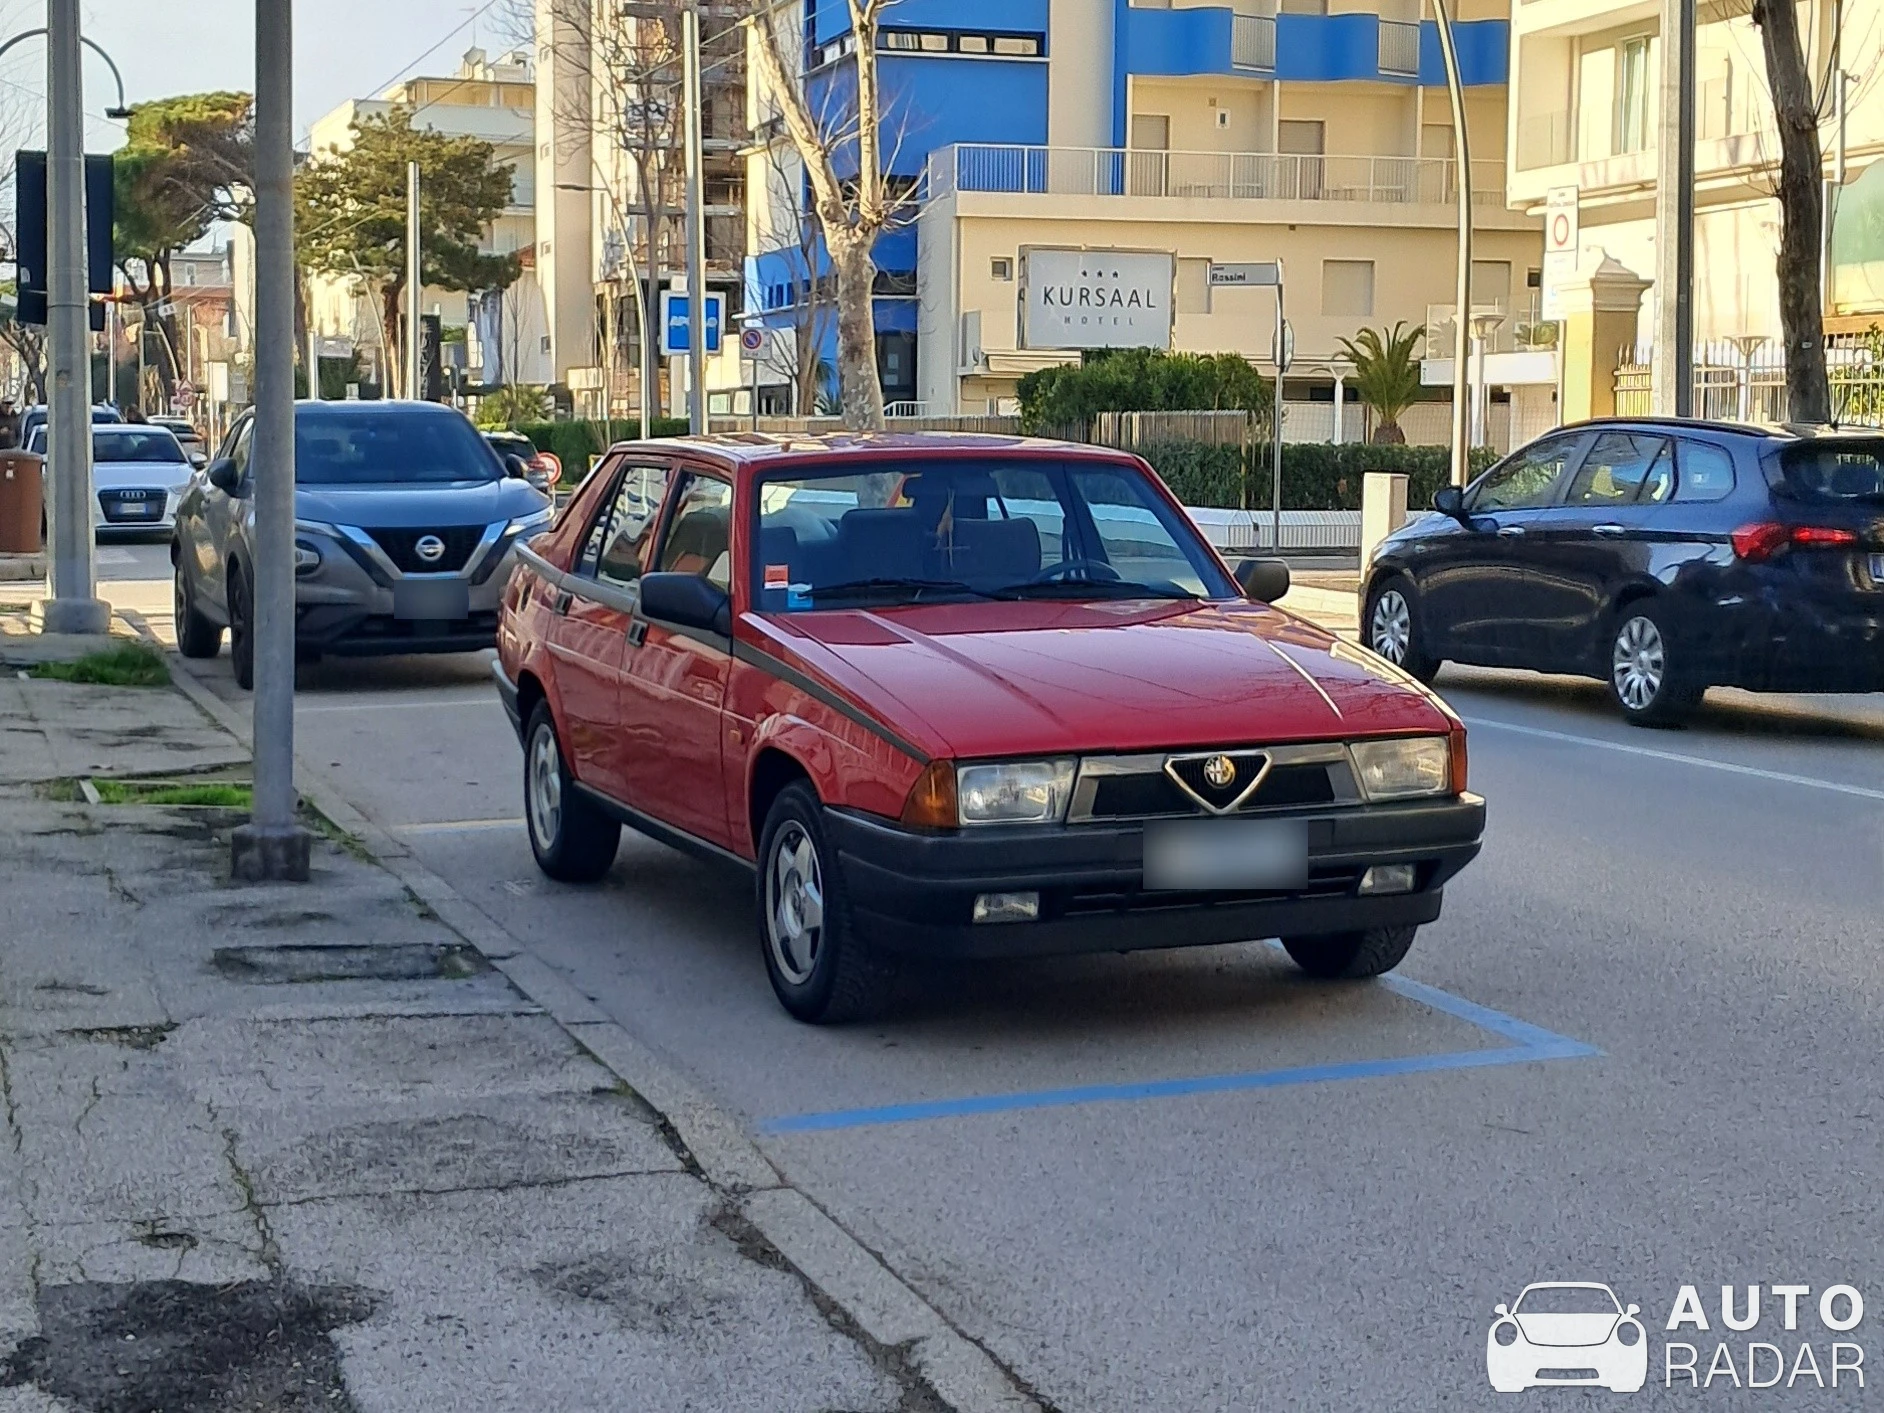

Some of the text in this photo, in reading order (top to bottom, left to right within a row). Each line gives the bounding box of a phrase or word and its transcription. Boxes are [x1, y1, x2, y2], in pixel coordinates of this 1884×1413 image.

[1211, 272, 1246, 282] Rossini
[1043, 286, 1156, 308] KURSAAL
[1064, 315, 1134, 326] HOTEL
